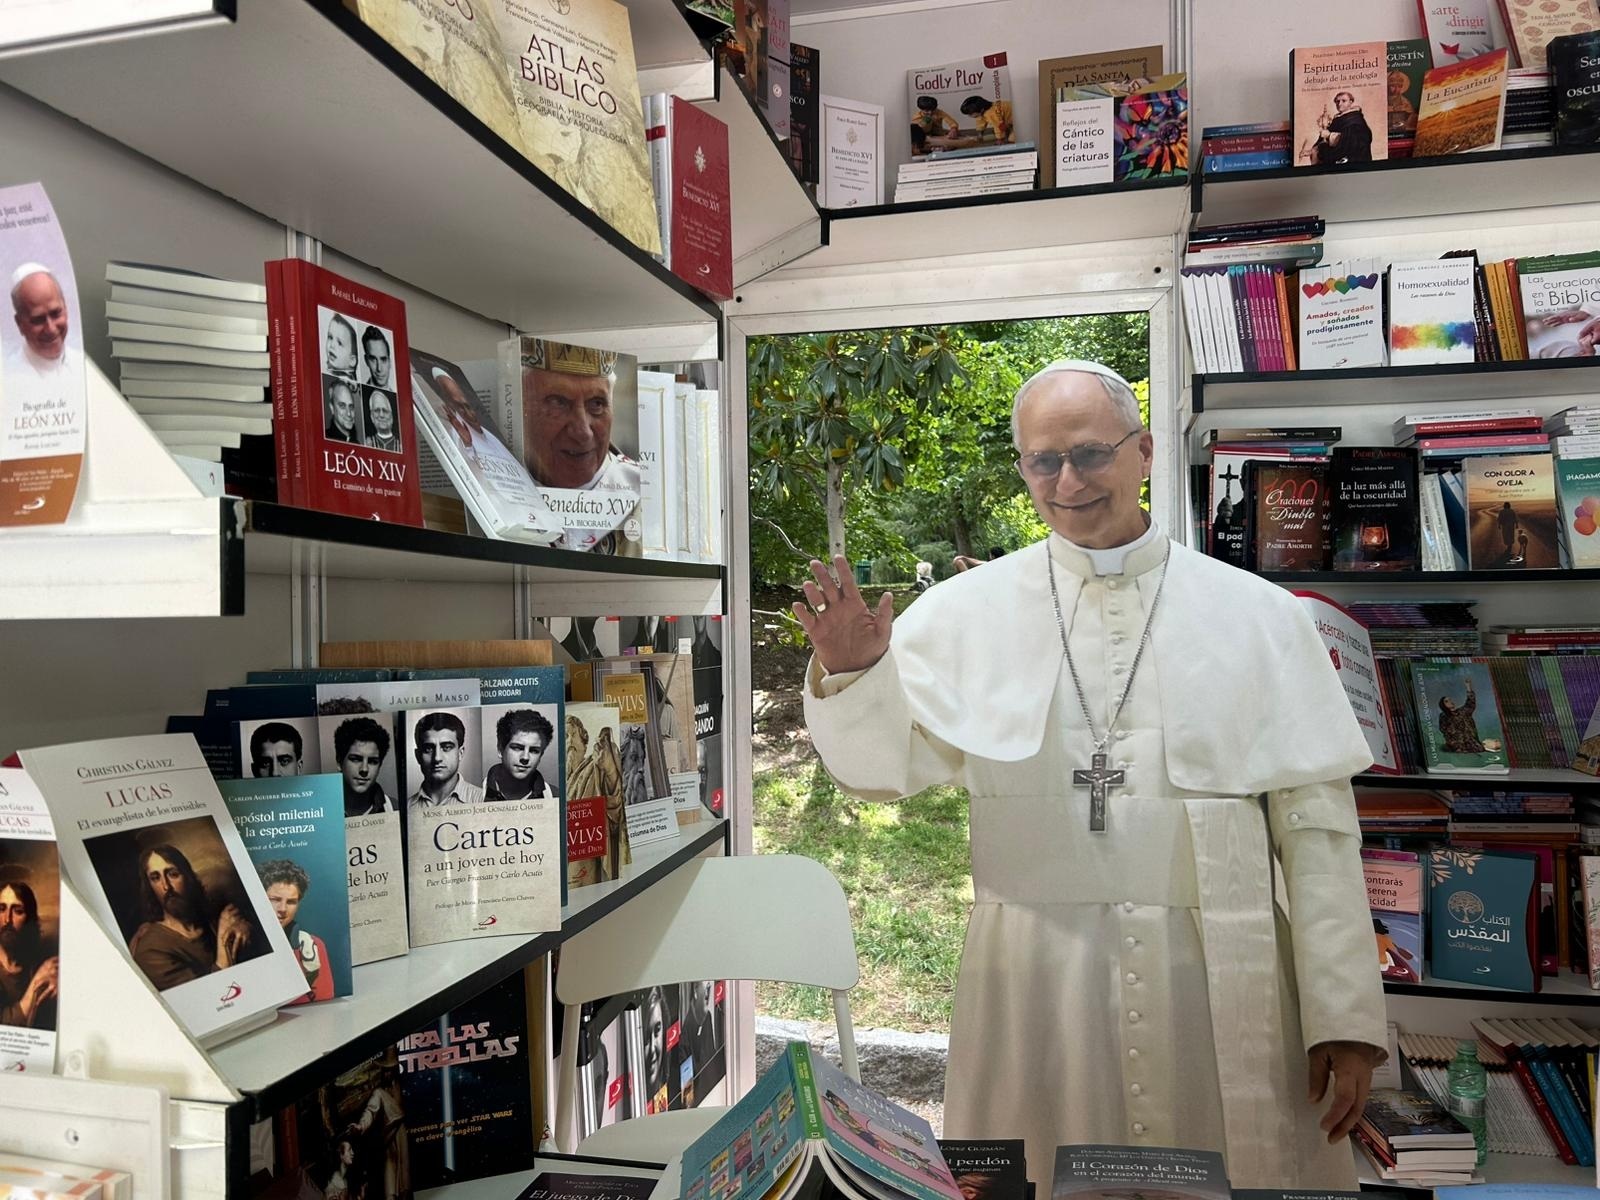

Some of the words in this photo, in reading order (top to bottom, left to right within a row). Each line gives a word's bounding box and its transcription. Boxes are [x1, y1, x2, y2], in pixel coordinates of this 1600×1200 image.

[1436, 5, 1460, 16] arte
[1450, 16, 1486, 29] dirigir
[527, 34, 605, 85] ATLAS
[1387, 50, 1425, 62] GUSTÍN
[1303, 57, 1379, 75] Espiritualidad
[915, 74, 952, 90] Godly
[956, 69, 984, 87] Play
[1076, 74, 1088, 84] LA
[1090, 71, 1125, 82] SANTA
[1304, 75, 1328, 85] debajo
[1329, 74, 1339, 82] de
[1340, 72, 1347, 81] la
[1349, 71, 1378, 82] teología
[520, 56, 617, 115] BÍBLICO
[1426, 91, 1441, 102] La
[1443, 74, 1499, 97] Eucaristía
[1062, 120, 1087, 128] Reflejos
[1088, 118, 1099, 126] del
[1062, 127, 1105, 139] Cántico
[1062, 142, 1077, 151] de
[1080, 140, 1095, 149] las
[832, 146, 860, 159] BENEDICTO
[860, 149, 873, 160] XVI
[1062, 151, 1110, 163] criaturas
[709, 199, 720, 213] XVI
[1397, 277, 1470, 291] Homosexualidad
[1528, 276, 1544, 284] Las
[331, 284, 351, 303] RAFAEL
[1534, 299, 1544, 307] la
[1306, 310, 1341, 321] Amados,
[1343, 304, 1374, 315] creados
[1327, 314, 1360, 325] soñados
[1306, 318, 1374, 336] prodigiosamente
[23, 400, 56, 414] Biografía
[57, 398, 67, 409] de
[14, 411, 49, 430] LEÓN
[52, 411, 76, 427] XIV
[323, 449, 374, 478] LEÓN
[378, 459, 407, 483] XIV
[1504, 469, 1527, 477] OLOR
[334, 479, 341, 489] El
[342, 482, 365, 493] camino
[367, 482, 374, 493] de
[375, 486, 383, 495] un
[384, 486, 402, 497] pastor
[1341, 482, 1352, 490] La
[1354, 482, 1367, 490] luz
[1369, 481, 1386, 490] más
[1389, 480, 1405, 489] allá
[1265, 489, 1315, 505] Oraciones
[1340, 492, 1350, 500] de
[1353, 491, 1361, 499] la
[1363, 490, 1407, 499] oscuridad
[542, 492, 603, 515] Benedicto
[606, 498, 635, 516] XVI
[564, 516, 575, 526] LA
[577, 519, 612, 528] BIOGRAFÍA
[1218, 532, 1225, 540] El
[1266, 542, 1286, 550] PADRE
[480, 678, 512, 688] SALZANO
[514, 677, 539, 687] ACUTIS
[389, 695, 428, 706] JAVIER
[435, 692, 470, 703] MANSO
[498, 689, 522, 697] RODARI
[76, 764, 134, 779] CHRISTIAN
[135, 757, 175, 771] GÁLVEZ
[104, 783, 173, 808] LUCAS
[253, 793, 280, 801] AGUIRRE
[77, 819, 91, 831] El
[92, 810, 144, 828] evangelista
[145, 806, 158, 818] de
[158, 804, 170, 815] los
[171, 799, 208, 813] invisibles
[234, 810, 275, 825] apóstol
[279, 807, 324, 821] milenial
[445, 808, 472, 816] ALBERTO
[473, 806, 486, 815] JOSÉ
[488, 804, 518, 813] GONZÁLEZ
[520, 802, 543, 811] CHAVES
[567, 809, 593, 820] ORTEA
[362, 817, 385, 827] CHAVES
[245, 825, 255, 837] la
[259, 824, 315, 838] esperanza
[433, 821, 535, 851] Cartas
[630, 829, 650, 839] columna
[656, 823, 667, 832] Dios
[268, 841, 287, 850] Carlo
[424, 863, 432, 873] a
[436, 861, 454, 870] un
[457, 856, 495, 872] joven
[499, 851, 515, 865] de
[520, 850, 545, 866] hoy
[365, 870, 389, 887] hoy
[426, 878, 440, 888] Pier
[500, 871, 520, 880] Carlo
[522, 869, 543, 878] Acutis
[1367, 888, 1398, 897] serena
[1482, 916, 1511, 927] الكتاب
[447, 1021, 490, 1043] LAS
[410, 1123, 438, 1134] recursos
[457, 1117, 469, 1125] ver
[470, 1114, 491, 1123] STAR
[492, 1109, 513, 1119] WARS
[956, 1156, 1011, 1167] perdón
[1072, 1161, 1086, 1169] El
[1089, 1161, 1149, 1171] Corazón
[1153, 1163, 1170, 1172] de
[1175, 1165, 1208, 1175] Dios
[1167, 1173, 1207, 1181] mundo
